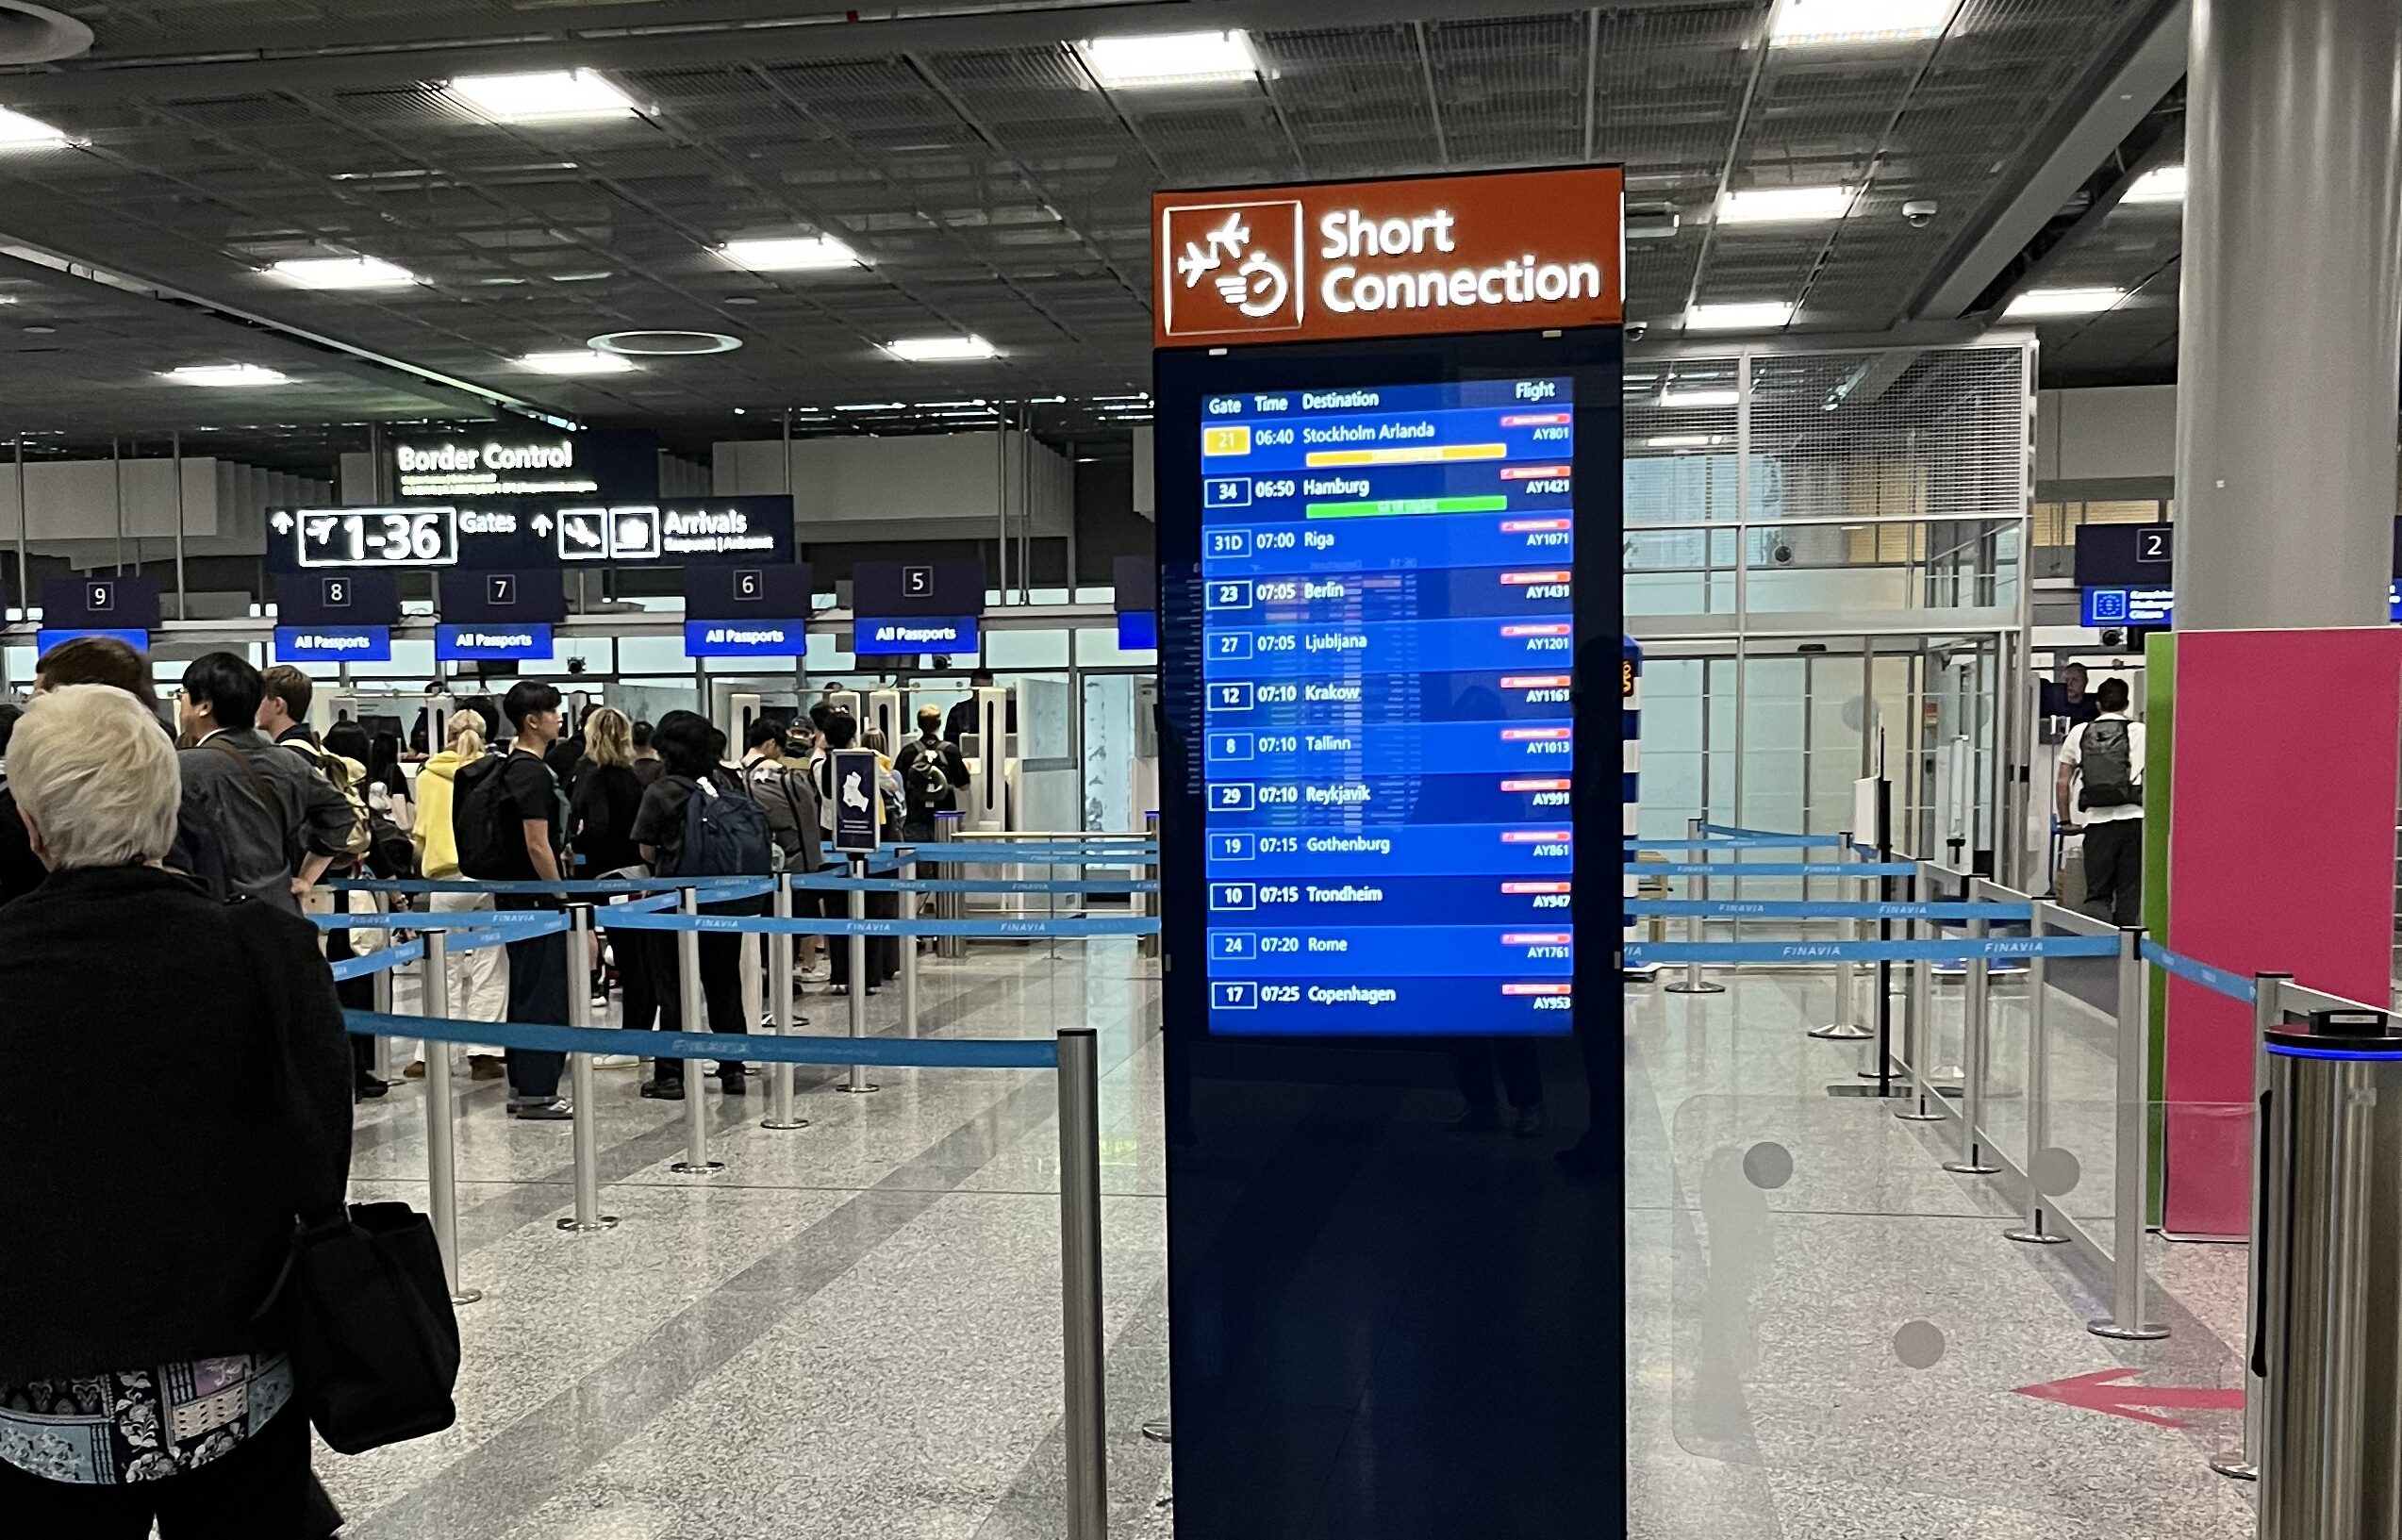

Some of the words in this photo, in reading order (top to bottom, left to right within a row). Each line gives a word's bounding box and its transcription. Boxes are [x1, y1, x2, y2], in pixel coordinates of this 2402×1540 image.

[1321, 209, 1455, 260] Short
[1321, 255, 1600, 314] Connection
[1209, 398, 1241, 414] Gate
[1254, 395, 1288, 412] Time
[1302, 390, 1379, 410] Destination
[1516, 381, 1555, 400] Flight
[1218, 433, 1234, 448] 21
[1256, 429, 1294, 445] 06:40
[1303, 424, 1376, 444] Stockholm
[1379, 422, 1434, 440] Arlanda
[1532, 427, 1568, 440] AY801
[398, 443, 479, 471] Border
[483, 440, 572, 469] Control
[1218, 485, 1237, 500] 34
[1255, 481, 1295, 497] 06:50
[1303, 478, 1369, 497] Hamburg
[1526, 480, 1569, 494] AY1421
[460, 511, 517, 534] Gates
[663, 509, 748, 535] Arrivals
[344, 514, 440, 560] 1-36
[1215, 536, 1243, 551] 31D
[1256, 534, 1295, 549] 07:00
[1304, 532, 1334, 549] Riga
[1527, 533, 1568, 545] AY1071
[2146, 536, 2162, 555] 2
[496, 581, 507, 598] 7
[741, 576, 754, 594] 6
[912, 572, 924, 590] 5
[94, 588, 107, 605] 9
[330, 584, 342, 601] 8
[1219, 586, 1238, 602] 23
[1256, 584, 1296, 600] 07:05
[1304, 582, 1345, 599] Berlin
[1526, 586, 1569, 599] AY1431
[294, 634, 312, 649] All
[315, 634, 370, 652] Passports
[456, 633, 473, 647] All
[476, 632, 533, 649] Passports
[705, 628, 723, 643] All
[727, 627, 785, 645] Passports
[876, 627, 894, 641] All
[897, 627, 956, 643] Passports
[1221, 638, 1238, 653] 27
[1257, 636, 1296, 651] 07:05
[1305, 634, 1367, 651] Ljubljana
[1527, 638, 1568, 650] AY1201
[1222, 687, 1239, 704] 12
[1257, 686, 1297, 702] 07:10
[1305, 684, 1360, 701] Krakow
[1526, 689, 1569, 703] AY1161
[1226, 738, 1235, 753] 8
[1259, 737, 1297, 752] 07:10
[1306, 736, 1351, 751] Tallinn
[1527, 741, 1569, 753] AY1013
[1222, 788, 1240, 803] 29
[1259, 787, 1298, 803] 07:10
[1306, 786, 1371, 803] Reykjavik
[1532, 793, 1569, 805] AY991
[1225, 838, 1241, 853] 19
[1260, 837, 1298, 853] 07:15
[1306, 836, 1390, 853] Gothenburg
[1532, 844, 1568, 856] AY861
[1225, 887, 1242, 902] 10
[1260, 886, 1299, 902] 07:15
[1306, 886, 1383, 902] Trondheim
[1532, 895, 1570, 908] AY947
[492, 914, 536, 922] FINAVIA
[1718, 904, 1764, 913] FINAVIA
[1879, 905, 1927, 915] FINAVIA
[695, 919, 738, 928] FINAVIA
[847, 923, 890, 932] FINAVIA
[1001, 923, 1046, 932] FINAVIA
[1225, 937, 1242, 952] 24
[1261, 937, 1299, 952] 07:20
[1308, 937, 1348, 952] Rome
[1527, 946, 1568, 958] AY1761
[1782, 946, 1841, 956] FINAVIA
[1984, 942, 2043, 953] FINAVIA
[1226, 986, 1243, 1002] 17
[1261, 985, 1300, 1002] 07:25
[1308, 986, 1396, 1004] Copenhagen
[1533, 997, 1571, 1010] AY953
